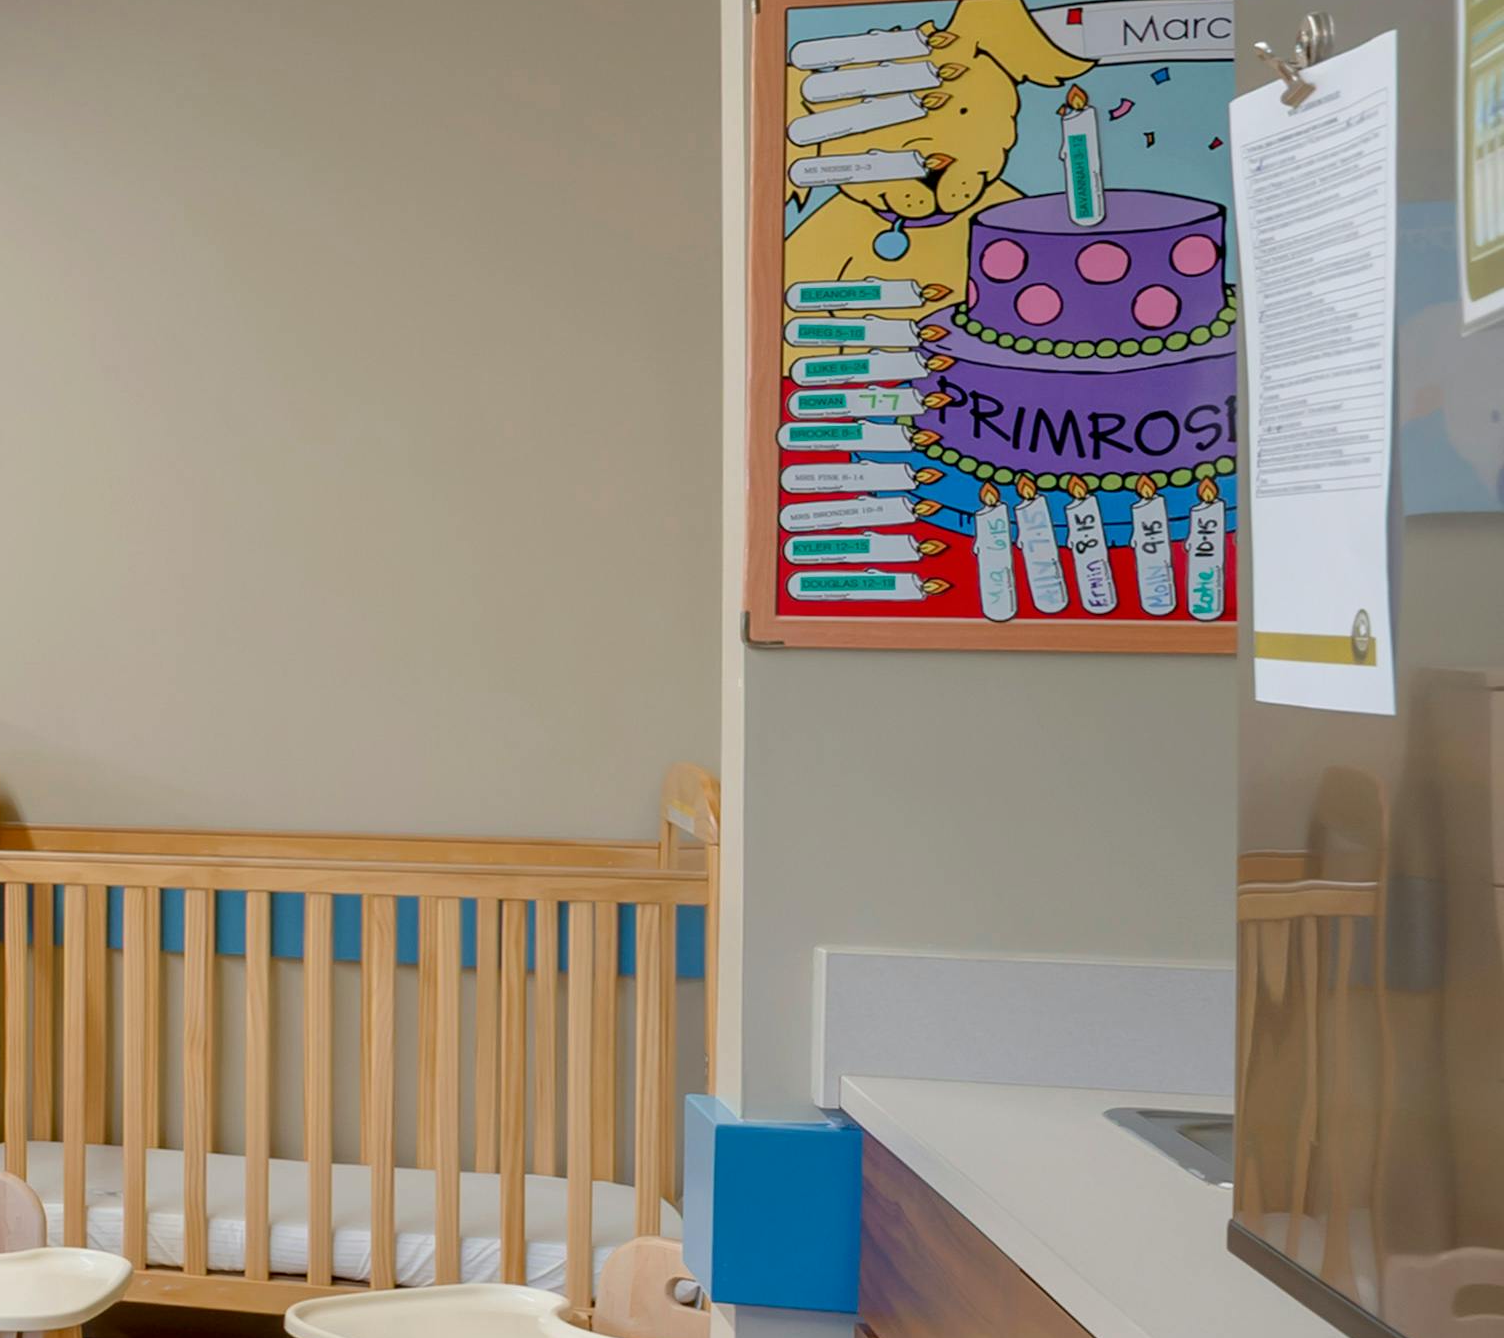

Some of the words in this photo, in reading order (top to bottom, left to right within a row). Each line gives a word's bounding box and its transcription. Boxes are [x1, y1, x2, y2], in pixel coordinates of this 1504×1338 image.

[1122, 14, 1233, 46] Marc
[800, 287, 856, 301] ELEANOR
[798, 325, 833, 337] GREG
[806, 363, 837, 374] LUKE
[798, 395, 844, 408] ROWAN
[790, 428, 839, 440] BROOKE
[793, 540, 832, 552] KYLER
[801, 578, 859, 590] DOUGLAS
